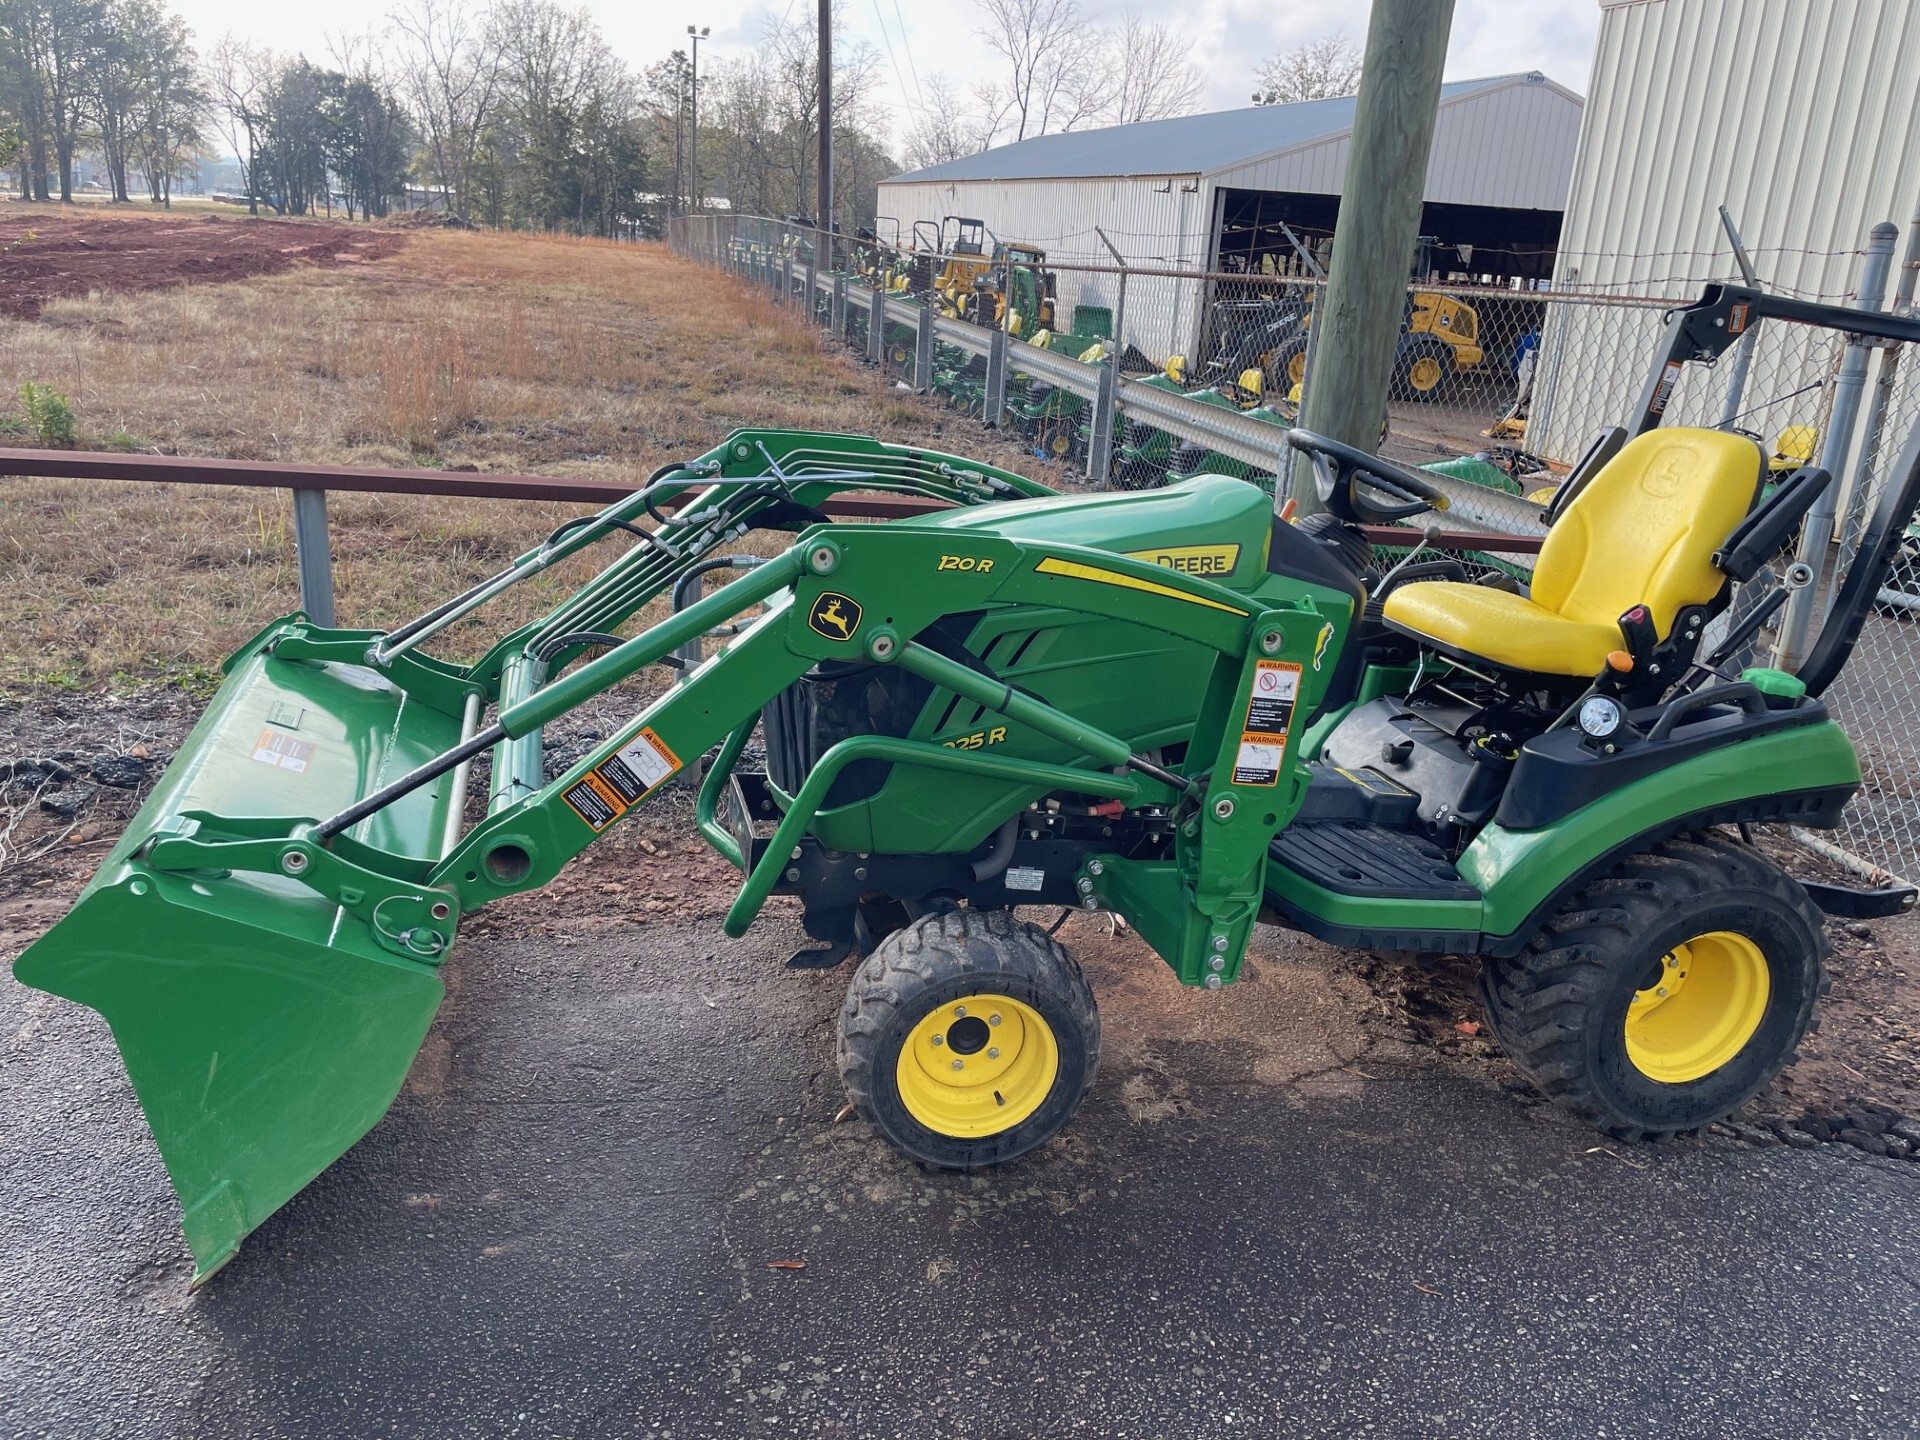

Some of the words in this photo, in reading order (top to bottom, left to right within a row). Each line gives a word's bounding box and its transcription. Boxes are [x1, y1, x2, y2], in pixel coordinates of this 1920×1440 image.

[1266, 312, 1297, 333] DEERE
[937, 555, 976, 571] 120
[975, 558, 995, 573] R
[1157, 555, 1226, 573] DEERE
[1265, 661, 1301, 671] WARNING
[988, 726, 1008, 745] R
[1249, 735, 1285, 745] WARNING
[651, 737, 678, 766] WARNING
[594, 783, 621, 811] WARNING
